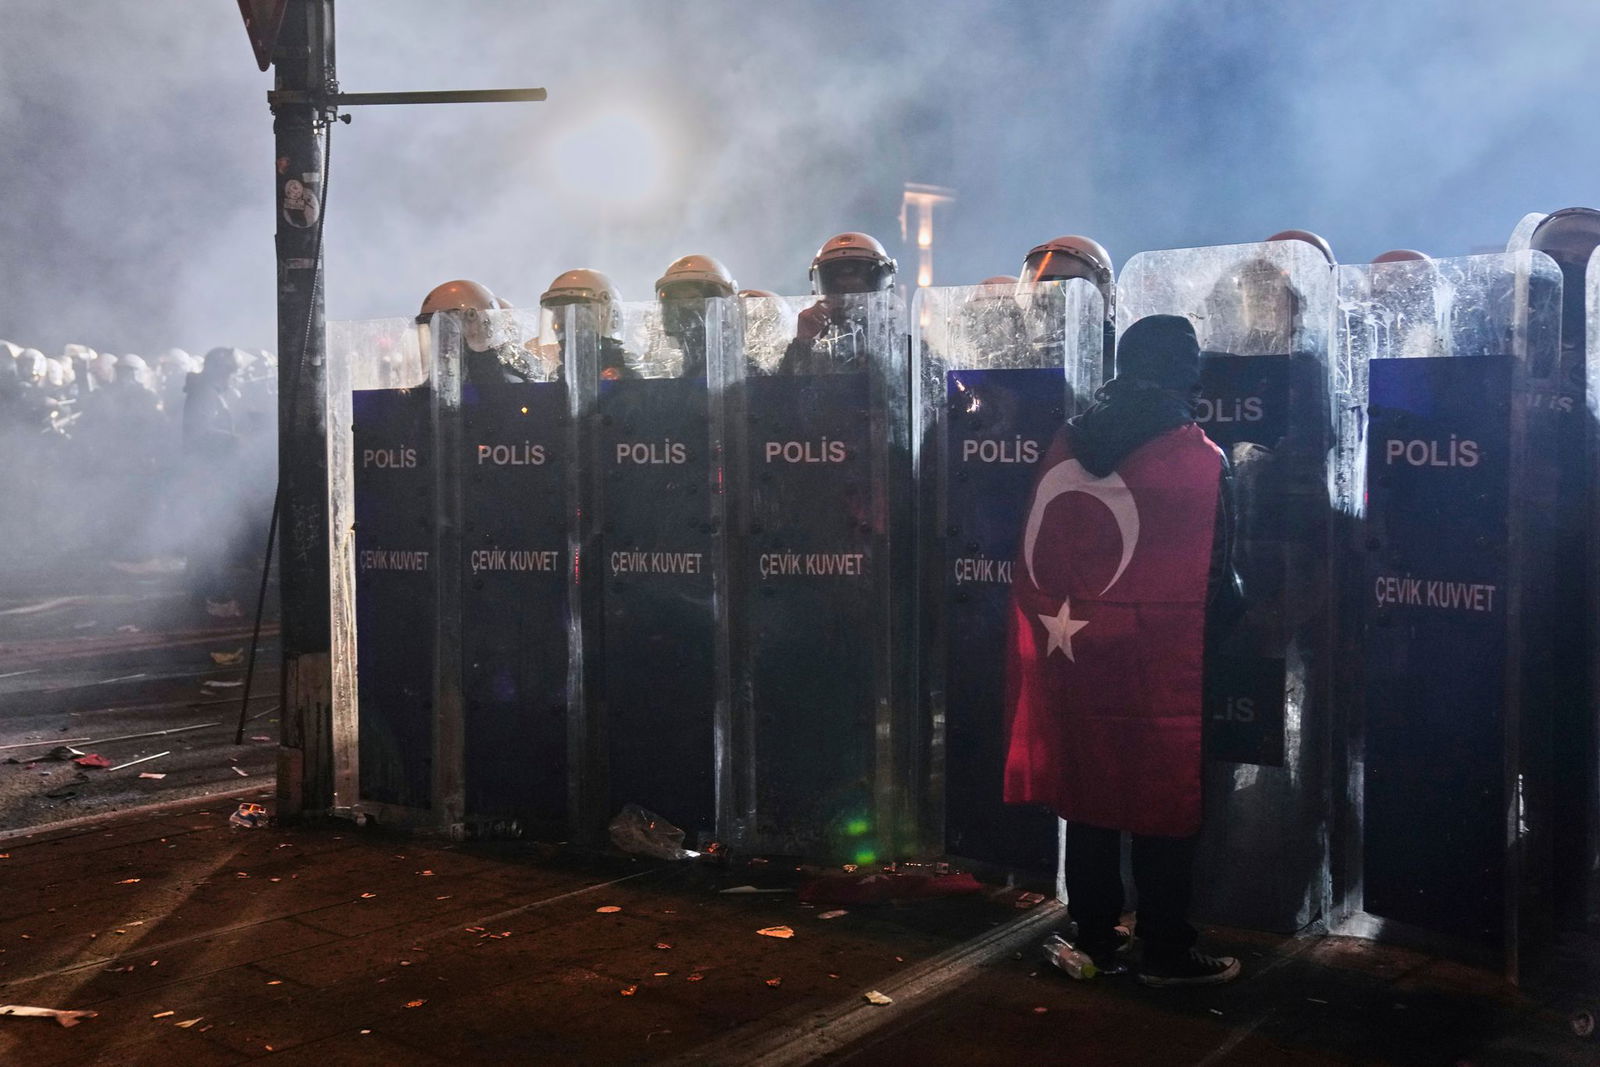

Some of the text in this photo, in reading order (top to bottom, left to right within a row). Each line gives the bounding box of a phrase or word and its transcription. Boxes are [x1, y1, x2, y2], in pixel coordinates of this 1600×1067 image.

[363, 444, 417, 468] POLİS
[478, 440, 546, 466] POLİS
[616, 438, 687, 465] POLİS
[765, 436, 847, 463] POLİS
[963, 434, 1039, 464] POLİS
[1386, 433, 1479, 468] POLİS
[360, 547, 429, 571] ÇEVİK KUVVET
[471, 546, 559, 575] ÇEVİK KUVVET
[611, 547, 702, 577] ÇEVİK KUVVET
[759, 549, 864, 580] ÇEVİK KUVVET
[954, 553, 994, 585] ÇEVİK
[1375, 573, 1496, 612] ÇEVİK KUVVET
